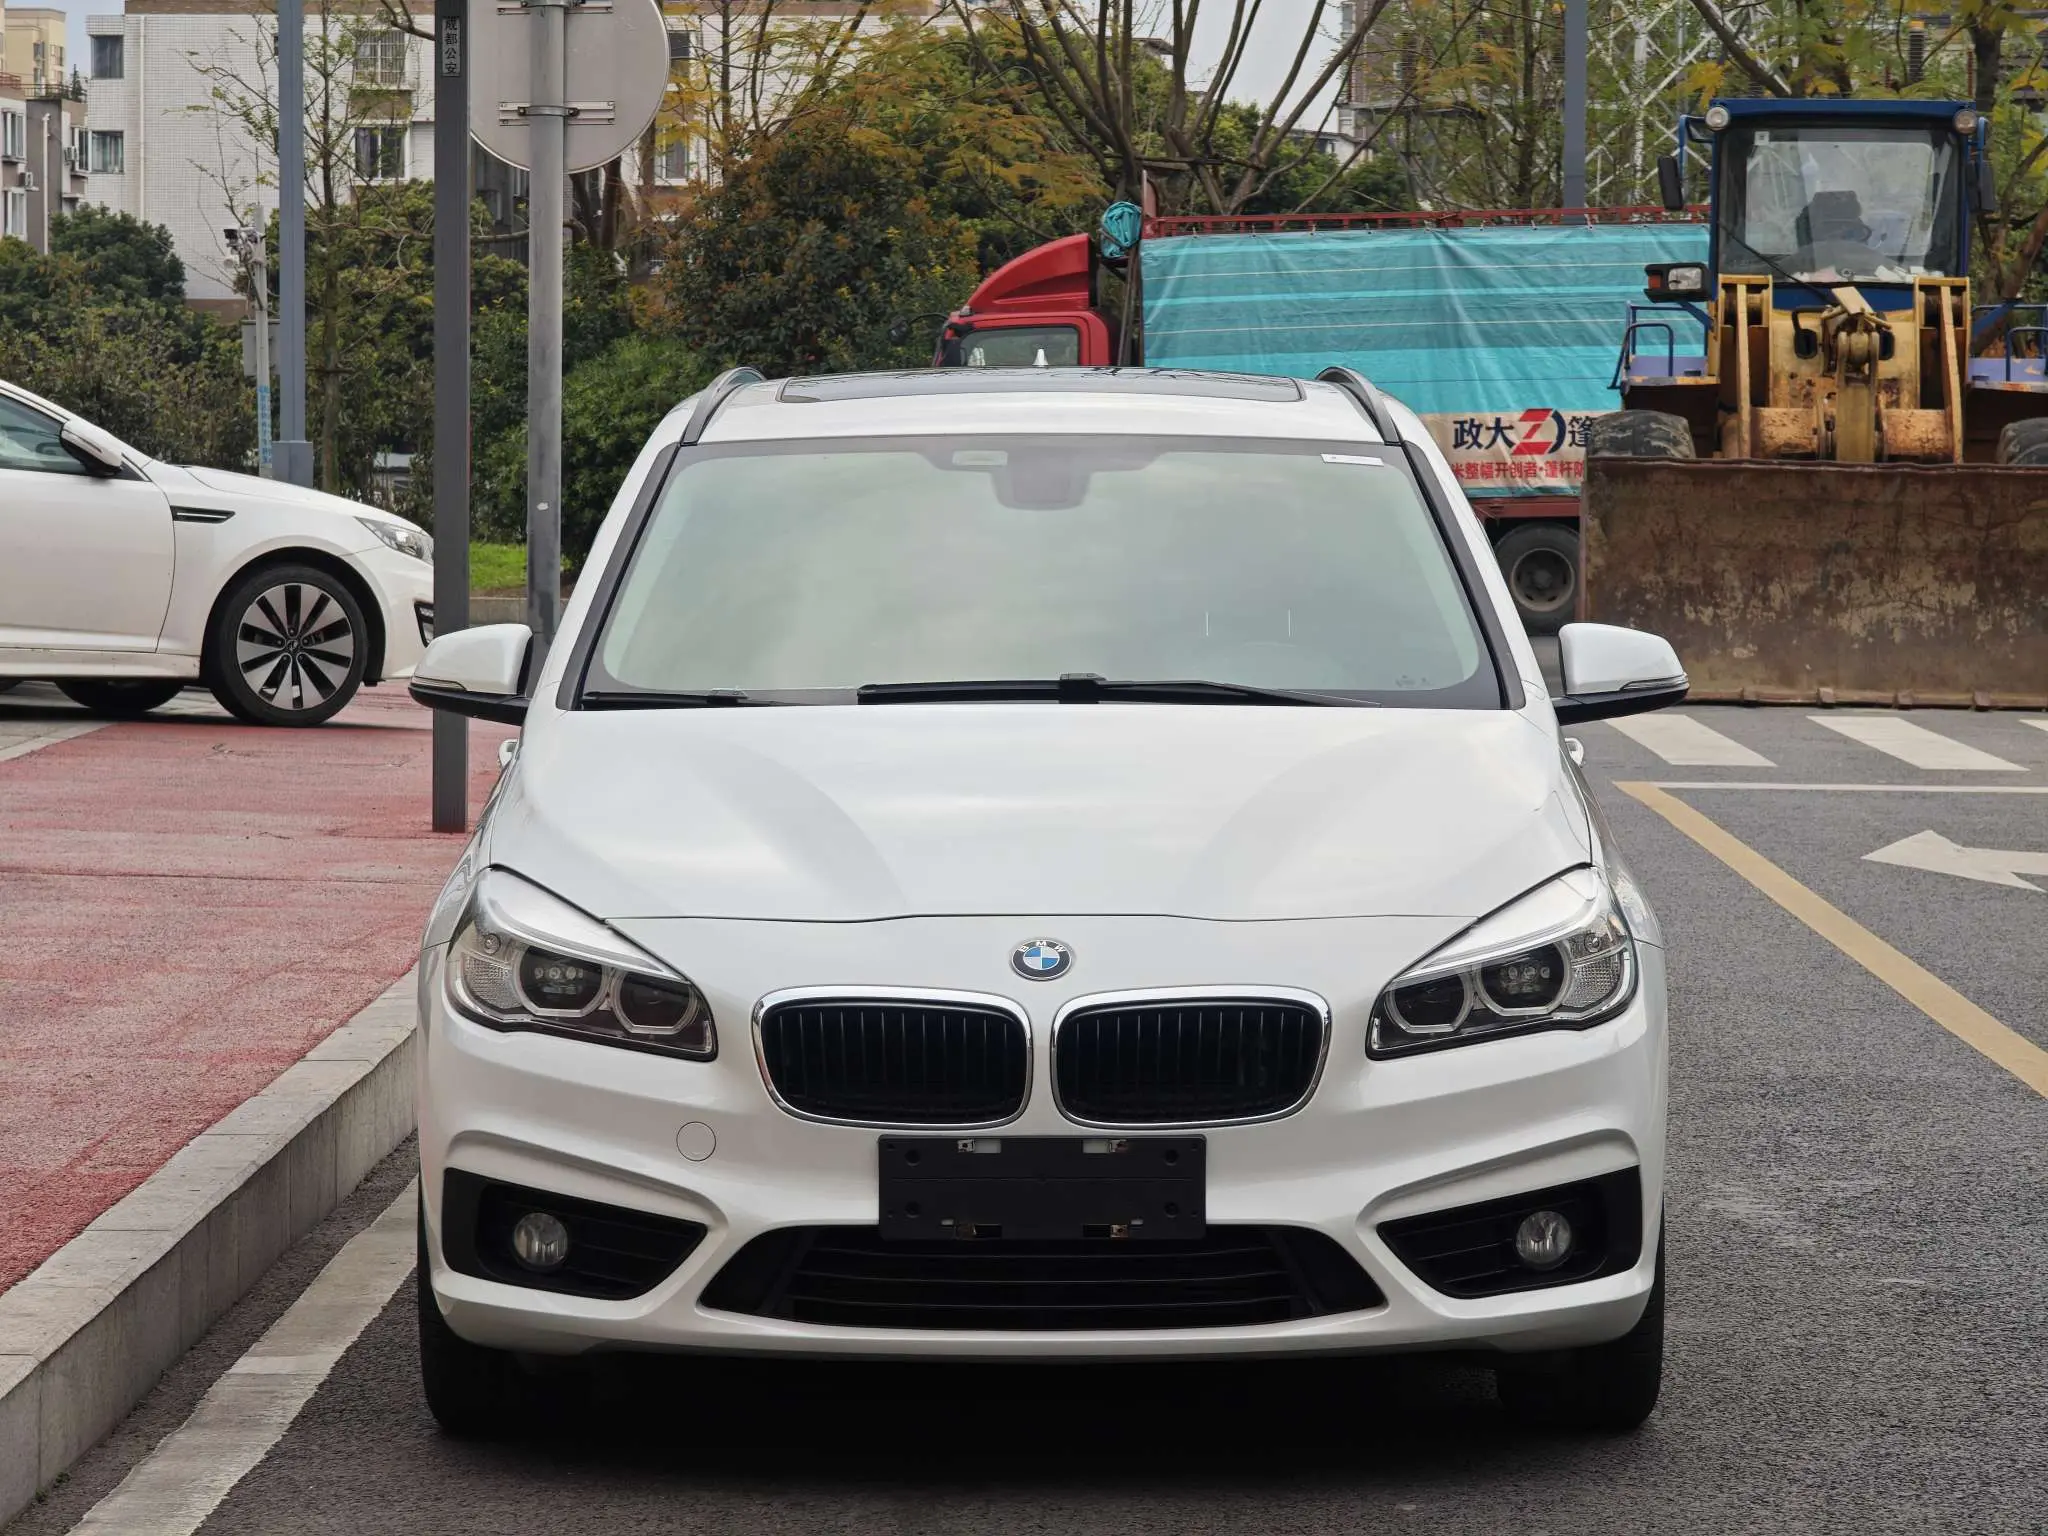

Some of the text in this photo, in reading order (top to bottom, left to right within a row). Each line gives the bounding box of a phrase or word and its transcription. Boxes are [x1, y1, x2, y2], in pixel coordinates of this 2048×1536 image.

[443, 17, 458, 75] 成都公安
[1018, 940, 1066, 953] BMW
